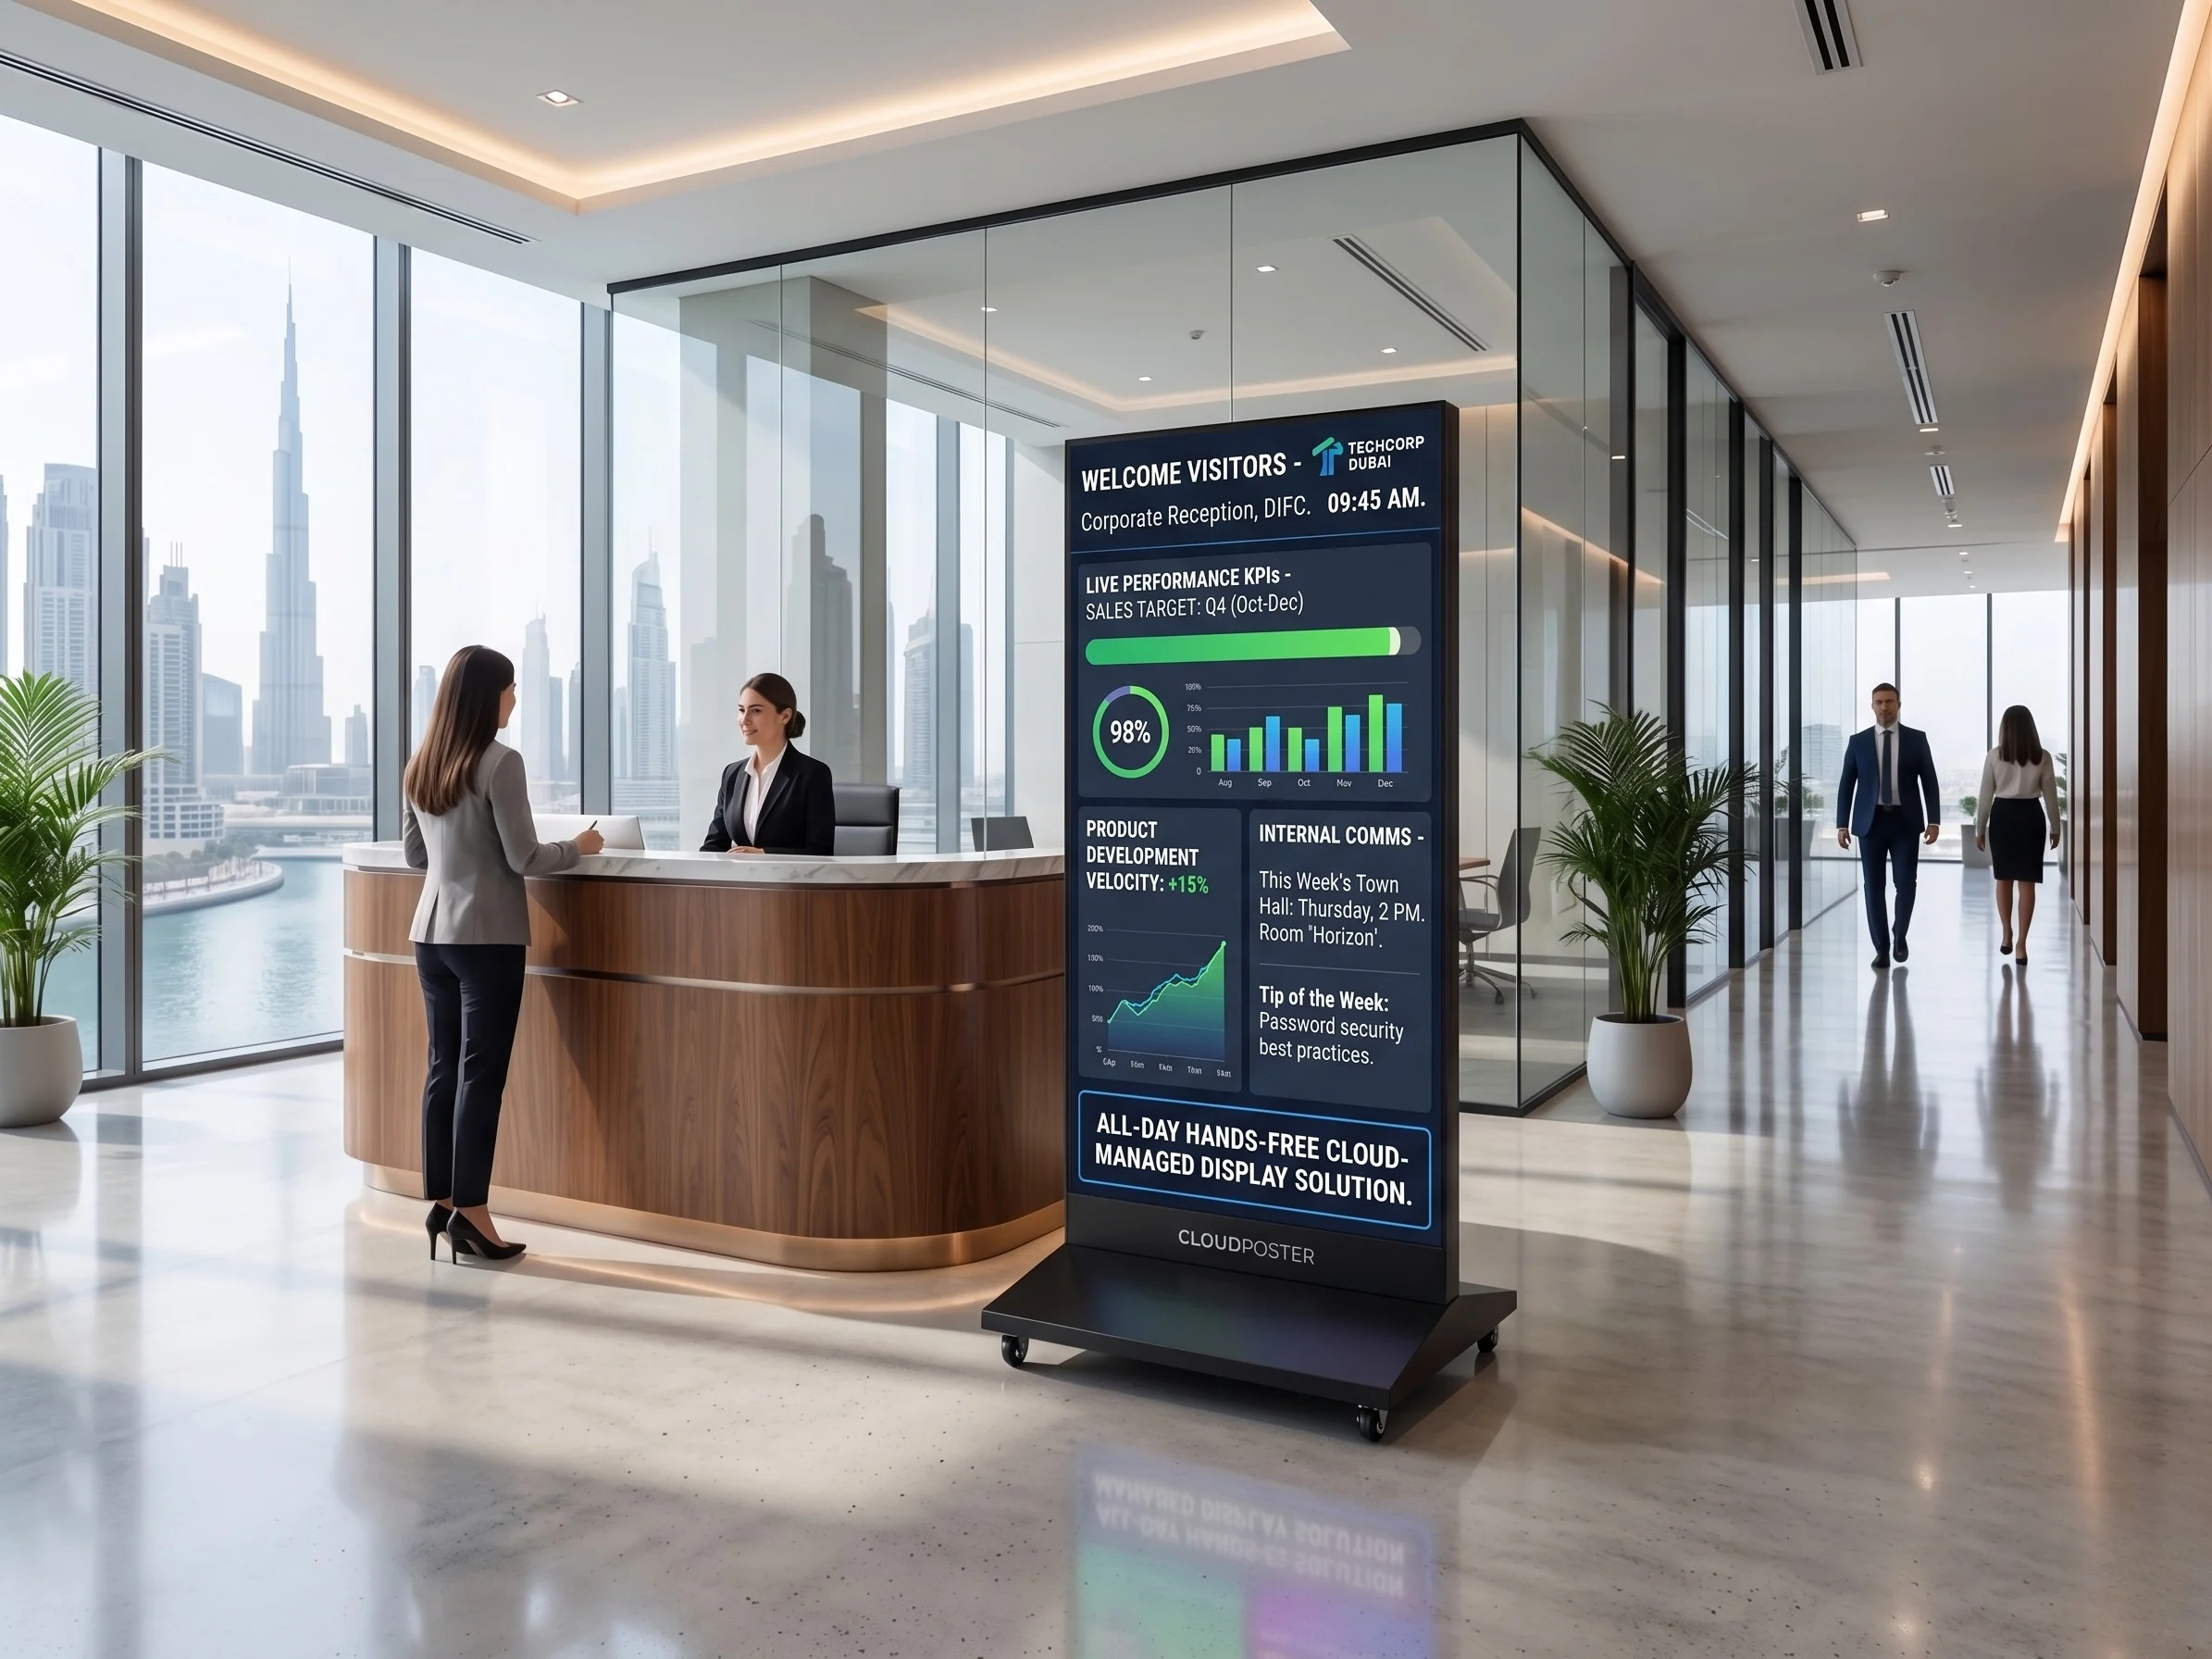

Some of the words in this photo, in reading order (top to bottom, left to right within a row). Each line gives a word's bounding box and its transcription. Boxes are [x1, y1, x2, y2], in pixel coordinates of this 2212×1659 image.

[1348, 436, 1424, 454] TECHCORP
[1082, 462, 1181, 492] WELCOME
[1187, 453, 1286, 482] VISITORS
[1349, 455, 1390, 470] DUBAI
[1328, 490, 1381, 513] 09:45
[1387, 487, 1425, 509] AM.
[1082, 509, 1162, 534] Corporate
[1169, 502, 1258, 527] Reception,
[1265, 496, 1310, 518] DIFC.
[1087, 576, 1118, 593] LIVE
[1124, 568, 1239, 592] PERFORMANCE
[1245, 567, 1279, 584] KPIs
[1087, 602, 1132, 619] SALES
[1137, 598, 1200, 617] TARGET:
[1206, 597, 1225, 616] Q4
[1232, 591, 1303, 617] (Oct-Dec)
[1111, 720, 1150, 743] 98%
[1219, 779, 1232, 788] Aug
[1259, 779, 1272, 787] Sep
[1087, 820, 1157, 838] PRODUCT
[1261, 825, 1340, 843] INTERNAL
[1346, 827, 1410, 845] COMMS
[1087, 846, 1199, 866] DEVELOPMENT
[1087, 872, 1163, 892] VELOCITY:
[1169, 876, 1208, 893] +15%
[1260, 870, 1291, 889] This
[1297, 872, 1350, 892] Week's
[1356, 874, 1398, 892] Town
[1261, 897, 1293, 915] Hall:
[1299, 899, 1373, 924] Thursday,
[1379, 903, 1388, 920] 2
[1395, 904, 1424, 921] PM.
[1261, 923, 1303, 942] Room
[1260, 986, 1284, 1008] Tip
[1289, 988, 1305, 1005] of
[1310, 989, 1335, 1007] the
[1340, 992, 1388, 1011] Week:
[1261, 1012, 1335, 1034] Password
[1341, 1022, 1403, 1044] security
[1261, 1038, 1292, 1057] best
[1298, 1044, 1373, 1064] practices.
[1097, 1113, 1179, 1141] ALL-DAY
[1186, 1122, 1320, 1160] HANDS-FREE
[1327, 1140, 1408, 1168] CLOUD-
[1096, 1143, 1194, 1175] MANAGED
[1201, 1156, 1287, 1188] DISPLAY
[1296, 1169, 1411, 1205] SOLUTION.
[1179, 1229, 1313, 1264] CLOUDPOSTER
